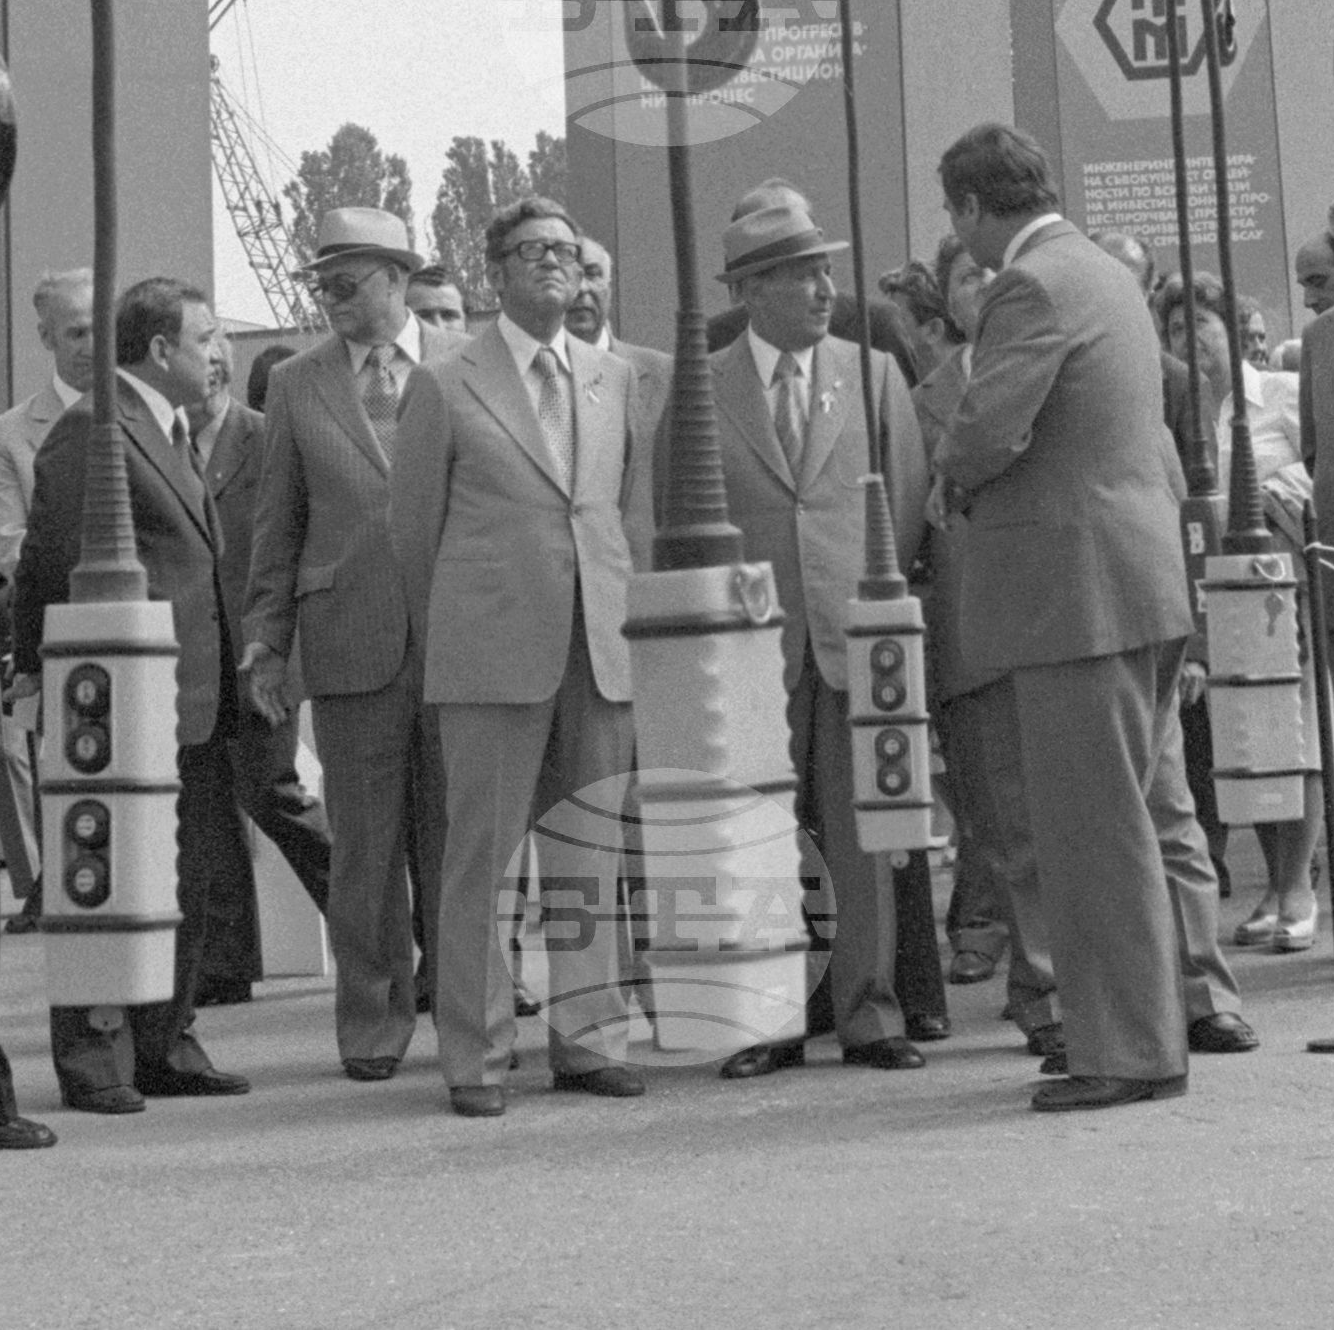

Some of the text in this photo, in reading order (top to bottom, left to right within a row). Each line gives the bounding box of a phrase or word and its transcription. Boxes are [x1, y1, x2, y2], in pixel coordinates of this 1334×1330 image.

[1083, 175, 1103, 187] НА
[1084, 187, 1129, 199] НОСТИ
[1131, 186, 1151, 198] ПО
[1085, 201, 1104, 213] НА
